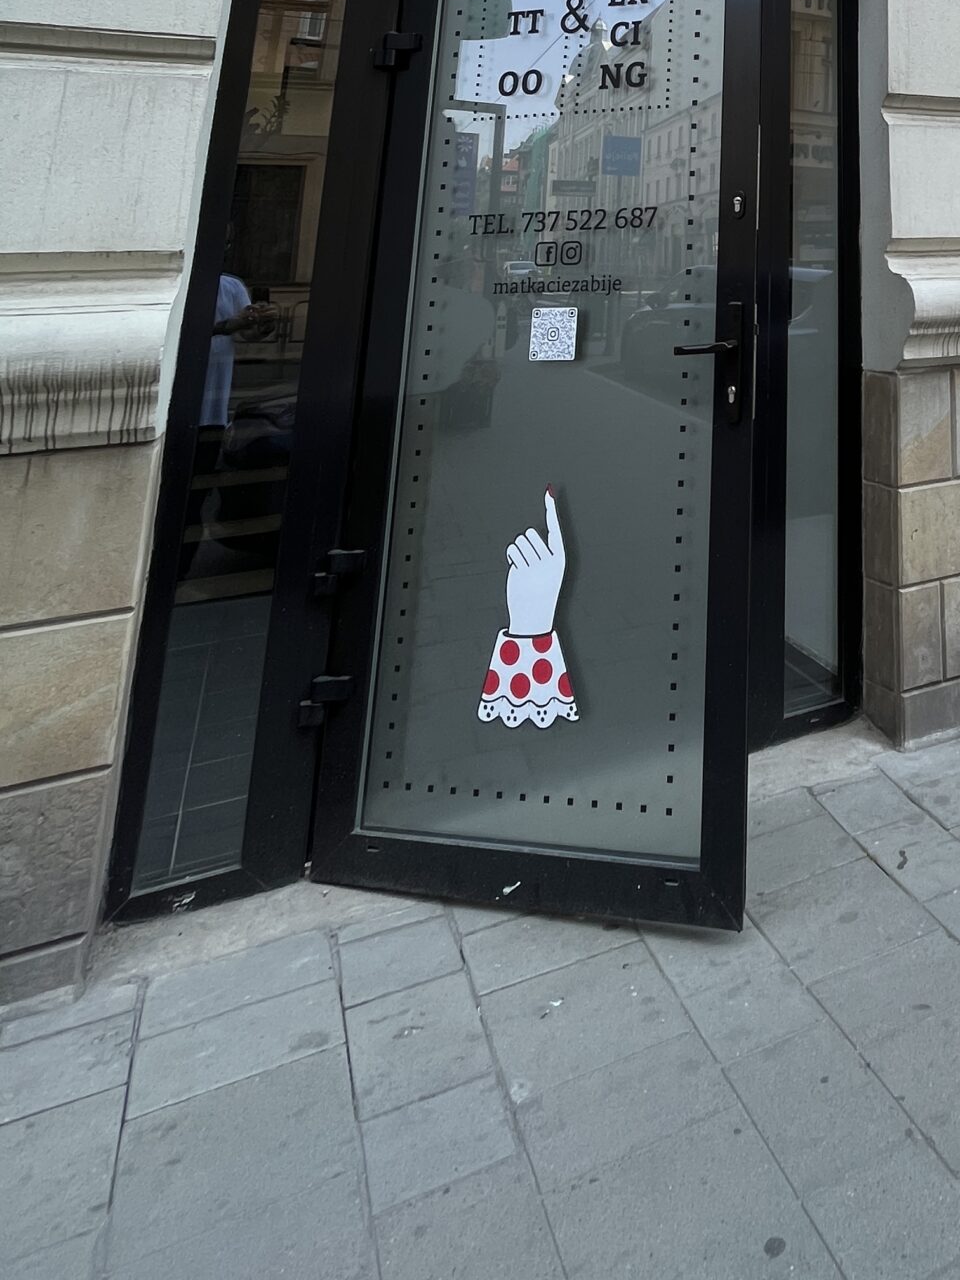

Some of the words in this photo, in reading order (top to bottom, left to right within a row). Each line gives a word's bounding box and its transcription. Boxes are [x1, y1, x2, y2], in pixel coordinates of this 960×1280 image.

[507, 9, 544, 36] TT
[610, 20, 643, 47] CI
[498, 69, 543, 97] OO
[598, 61, 648, 90] NG
[469, 213, 514, 236] TEL.
[521, 211, 561, 233] 737
[565, 209, 607, 231] 522
[615, 206, 658, 229] 687
[492, 274, 622, 296] matkaciezabije
